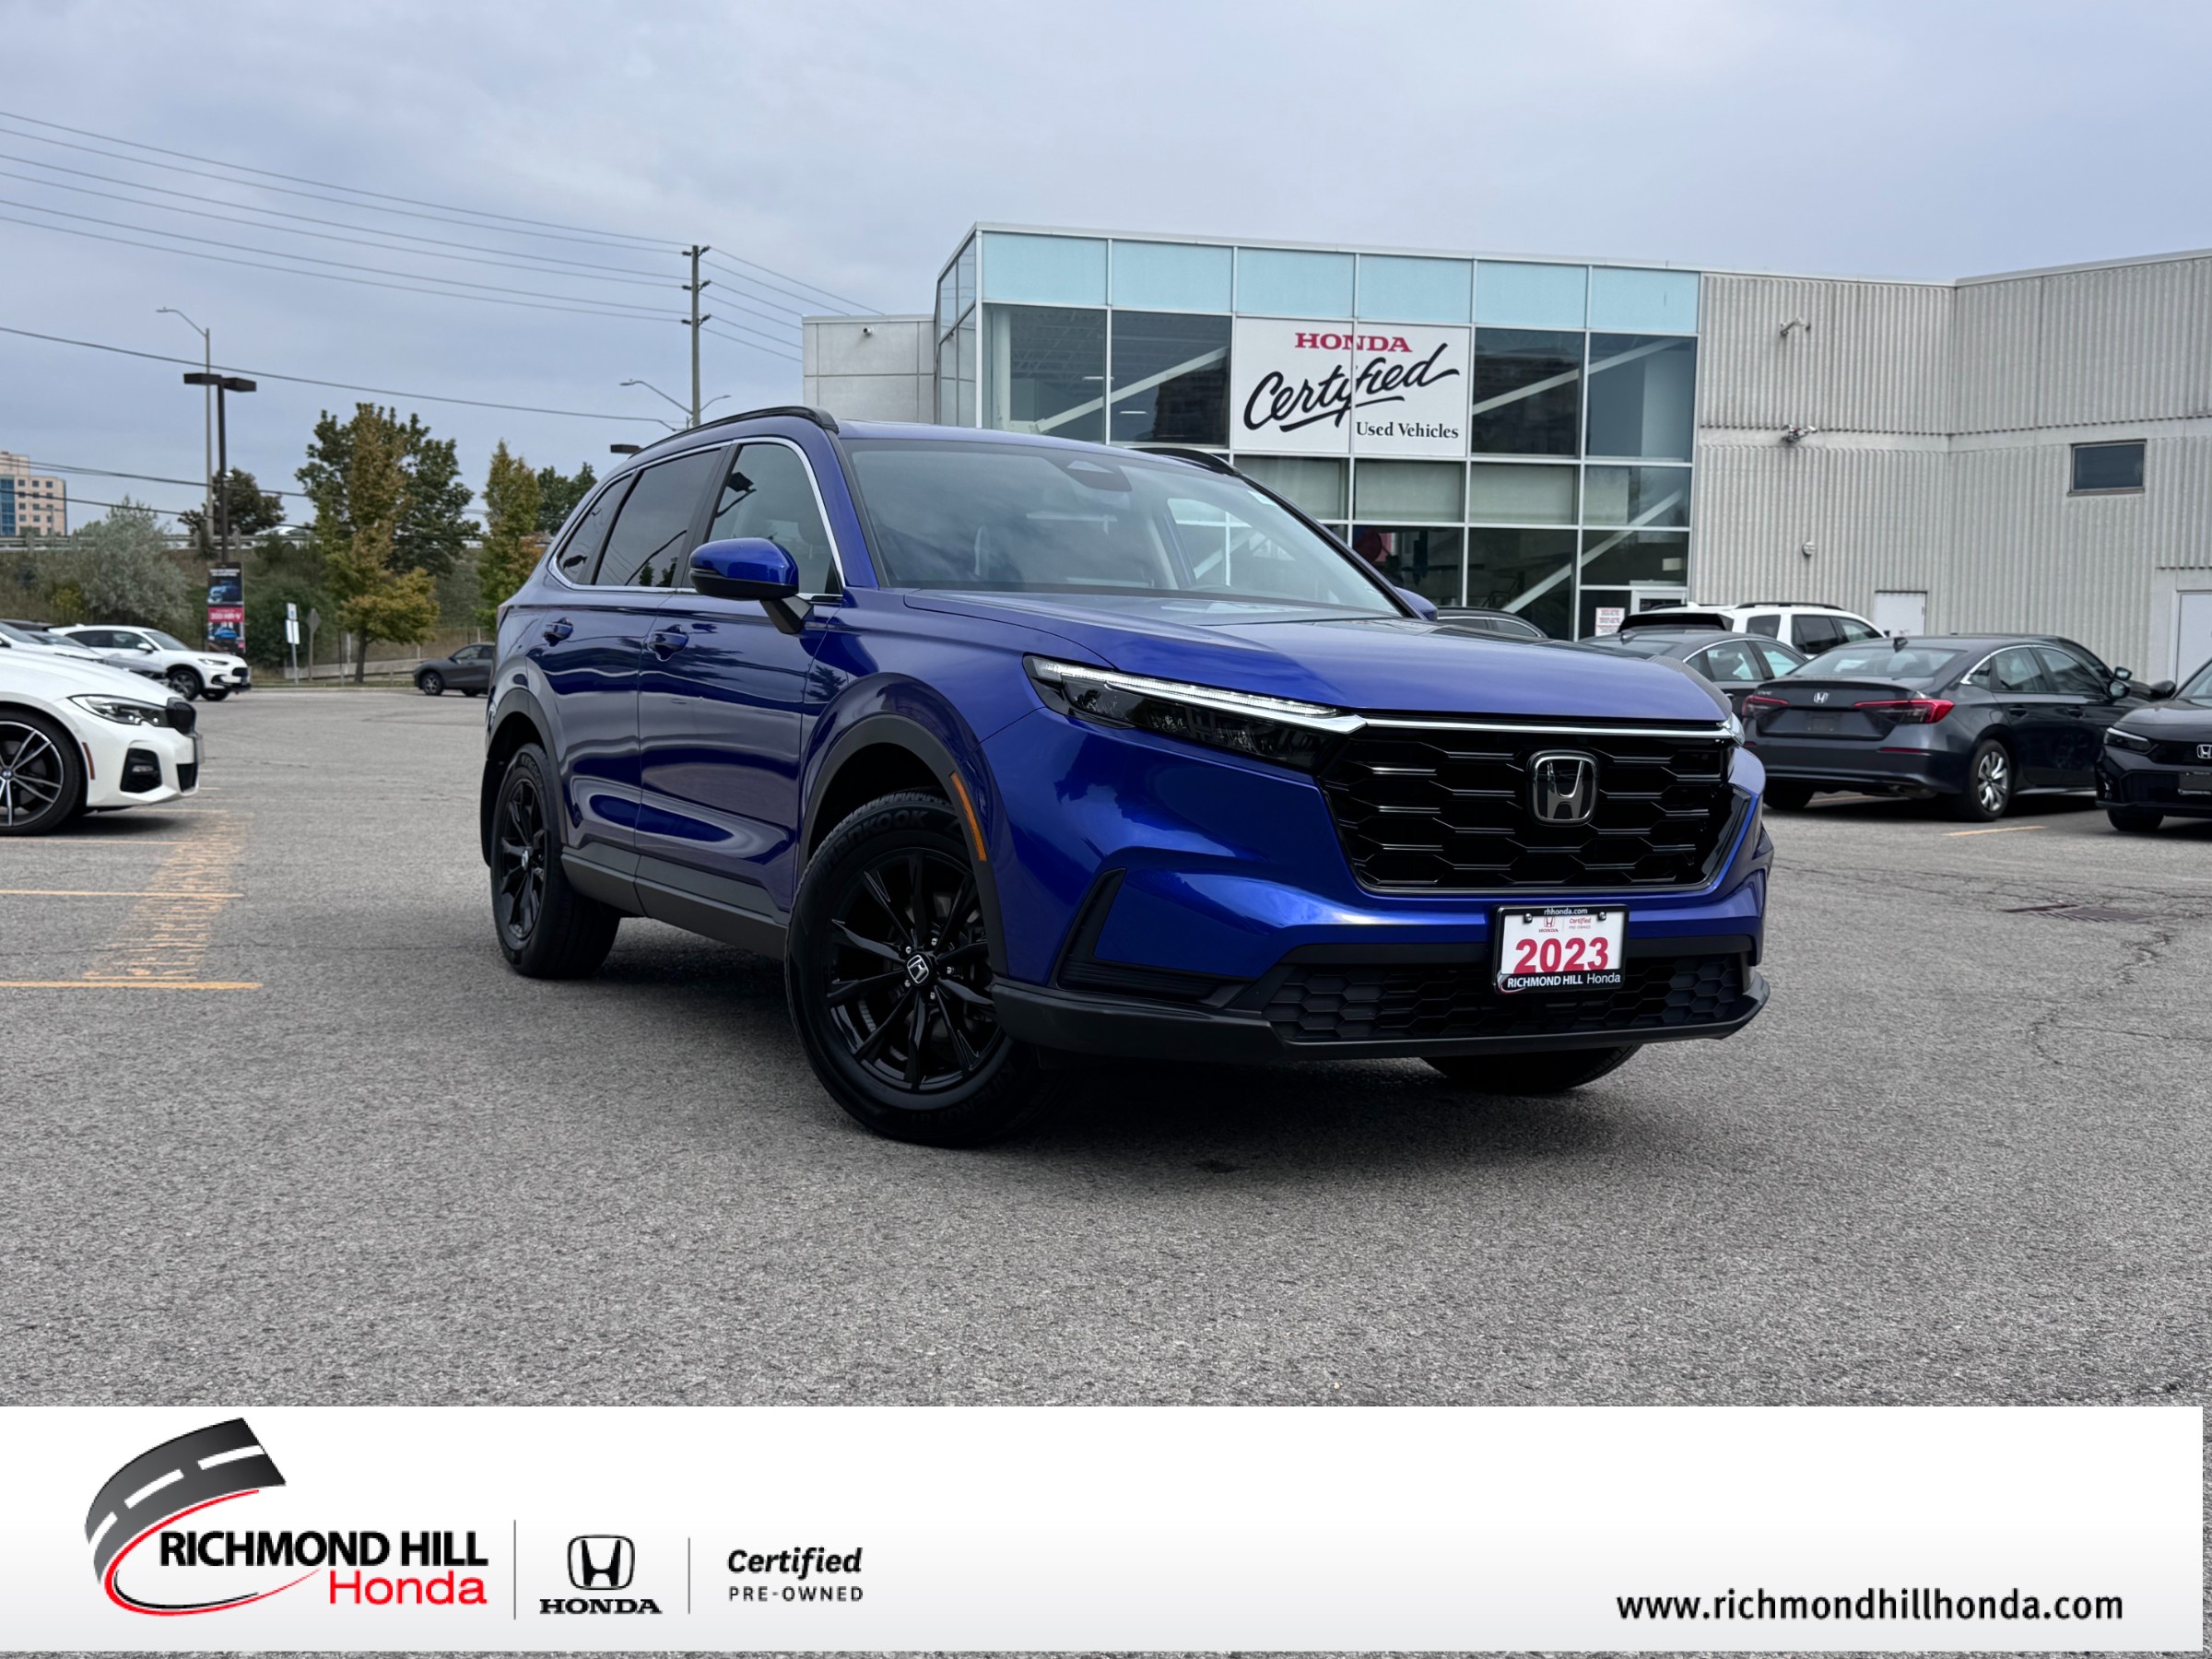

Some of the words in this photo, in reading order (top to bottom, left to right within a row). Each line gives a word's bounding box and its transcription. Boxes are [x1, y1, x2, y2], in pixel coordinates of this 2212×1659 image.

[1295, 332, 1413, 353] HONDA
[1243, 342, 1460, 432] Certified
[1356, 421, 1394, 437] Used
[1398, 423, 1459, 439] Vehicles
[1544, 907, 1588, 915] rhhonda.com
[1513, 936, 1608, 973] 2023
[1508, 976, 1561, 988] RICHMOND
[1562, 976, 1583, 985] HILL
[1587, 972, 1620, 984] Honda
